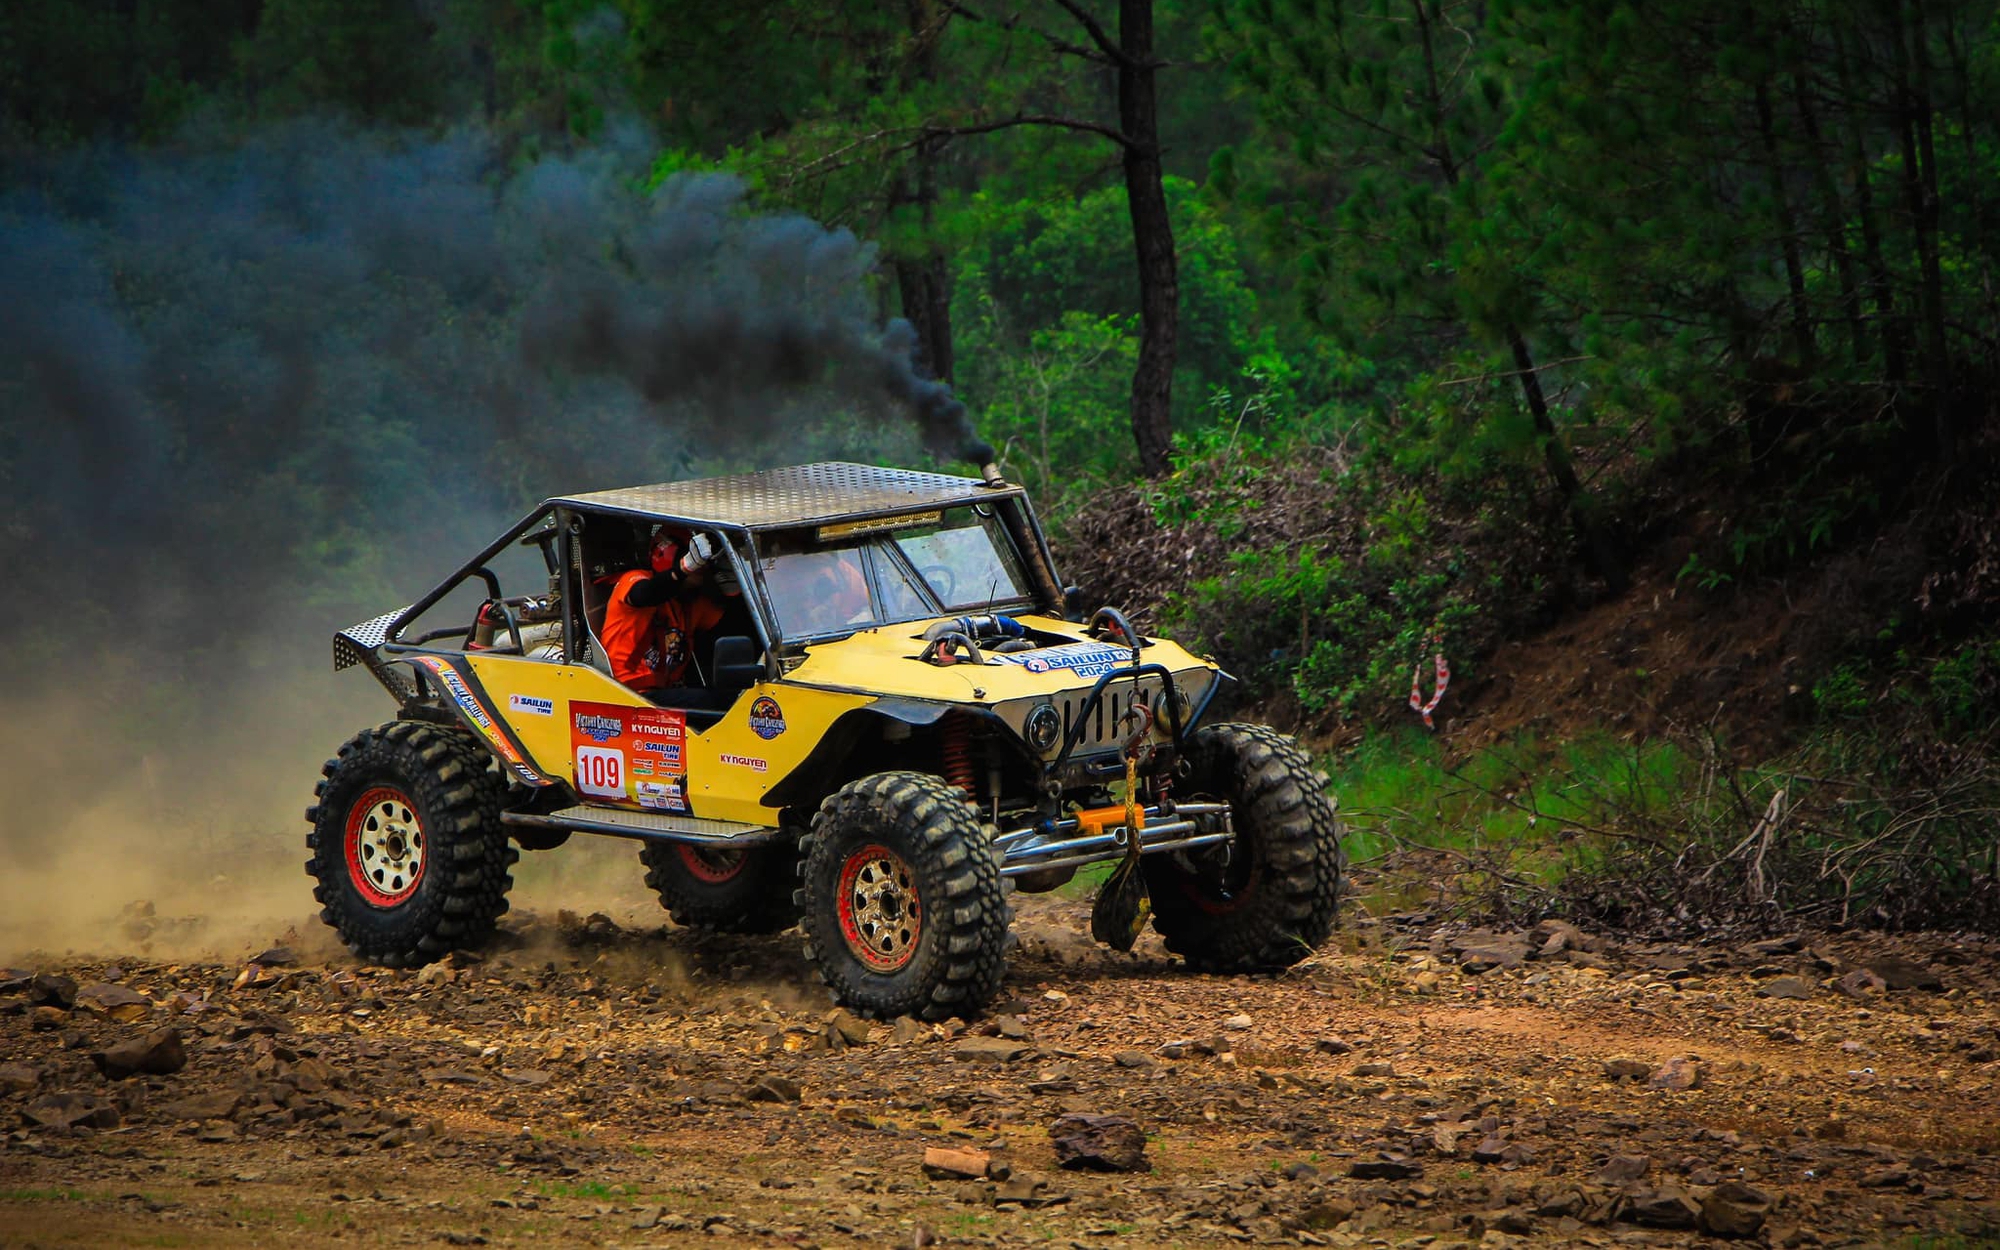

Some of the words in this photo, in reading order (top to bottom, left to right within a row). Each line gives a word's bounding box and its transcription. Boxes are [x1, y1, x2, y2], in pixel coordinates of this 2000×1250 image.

[1049, 652, 1112, 669] SAILUN
[1077, 664, 1113, 678] 2024
[520, 697, 552, 709] SAILUN
[645, 742, 680, 753] SAILUN
[515, 763, 538, 780] 109
[580, 754, 620, 789] 109
